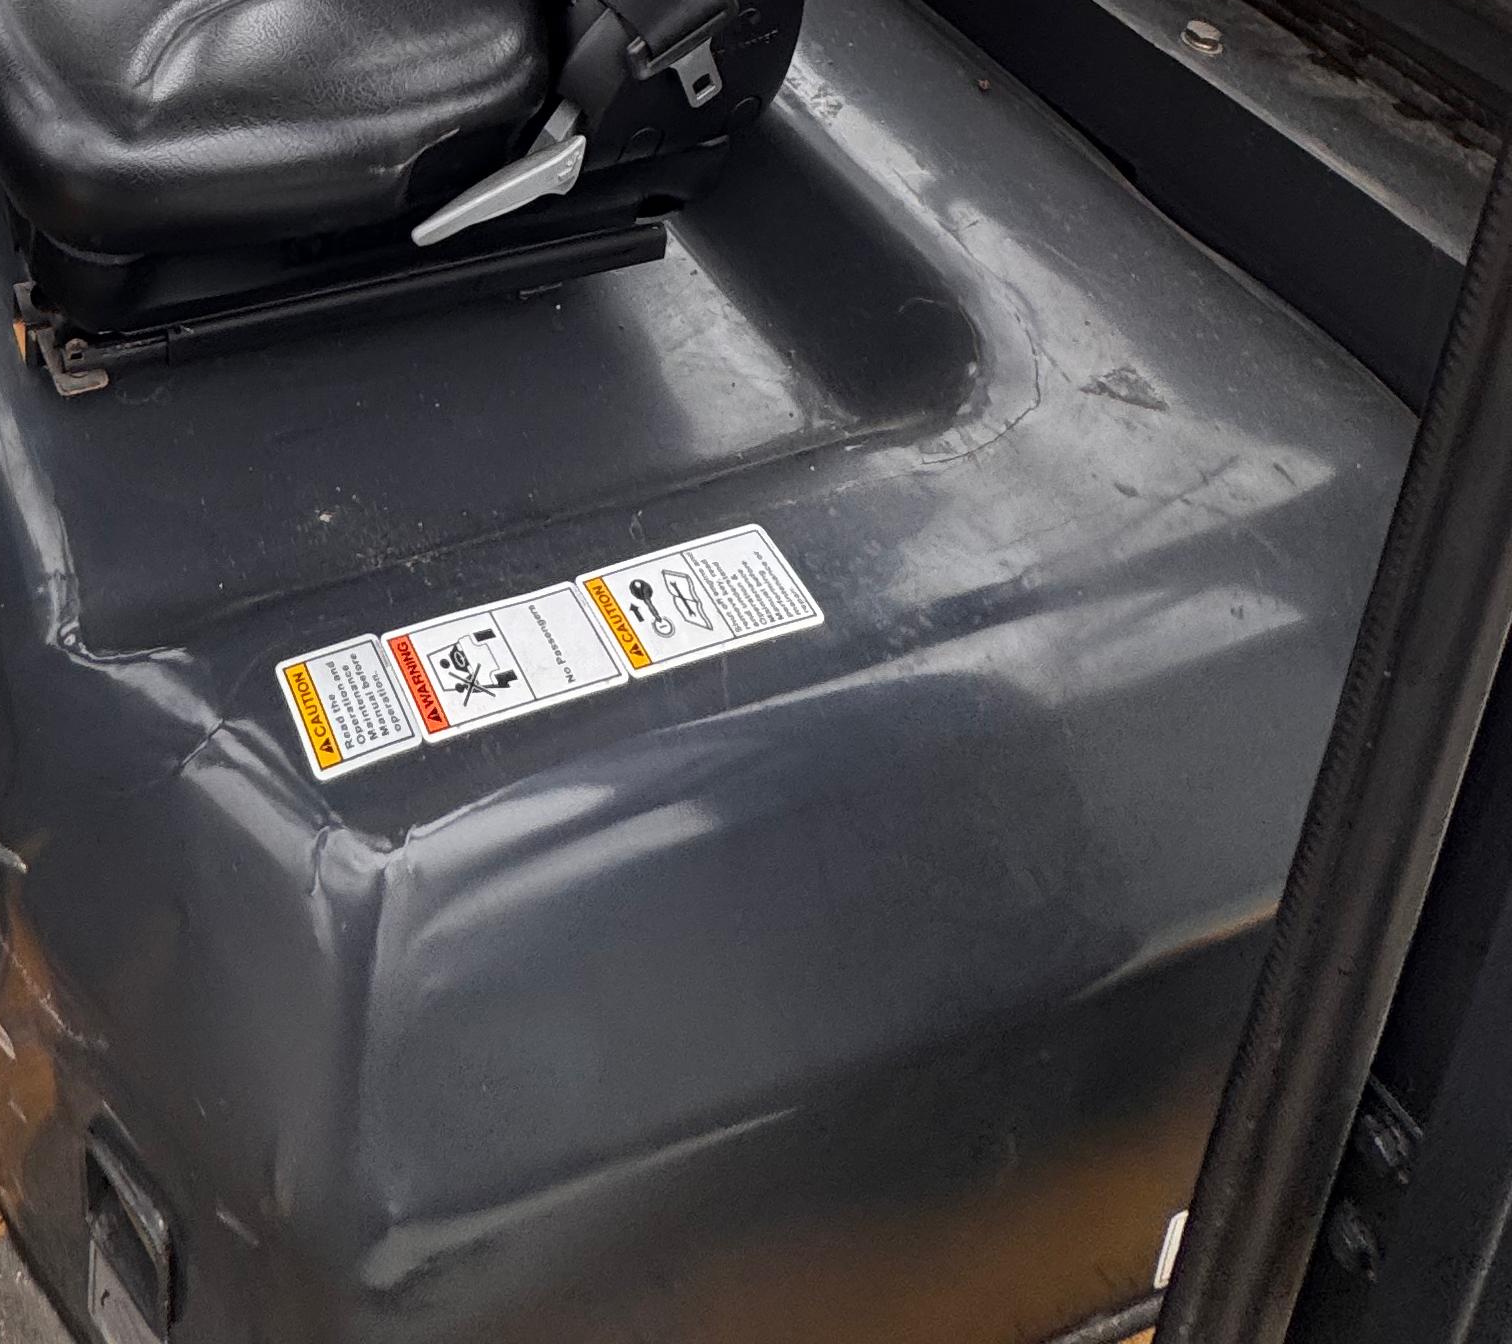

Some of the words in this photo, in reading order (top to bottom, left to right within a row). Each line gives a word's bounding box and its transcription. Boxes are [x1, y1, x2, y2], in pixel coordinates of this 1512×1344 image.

[592, 584, 634, 643] CAUTION
[736, 581, 767, 625] Operation
[737, 568, 776, 622] Maintenance
[759, 587, 784, 620] Manual
[761, 560, 801, 615] maintenance
[527, 604, 566, 665] Passengers
[324, 660, 341, 681] and
[349, 653, 370, 689] before
[396, 641, 433, 708] WARNING
[563, 666, 576, 683] No
[292, 671, 326, 737] CAUTION
[327, 693, 340, 713] the
[336, 682, 366, 745] Operation
[341, 664, 378, 740] Maintenance
[364, 690, 389, 736] Manual
[371, 670, 401, 732] operation.
[334, 715, 355, 750] Read
